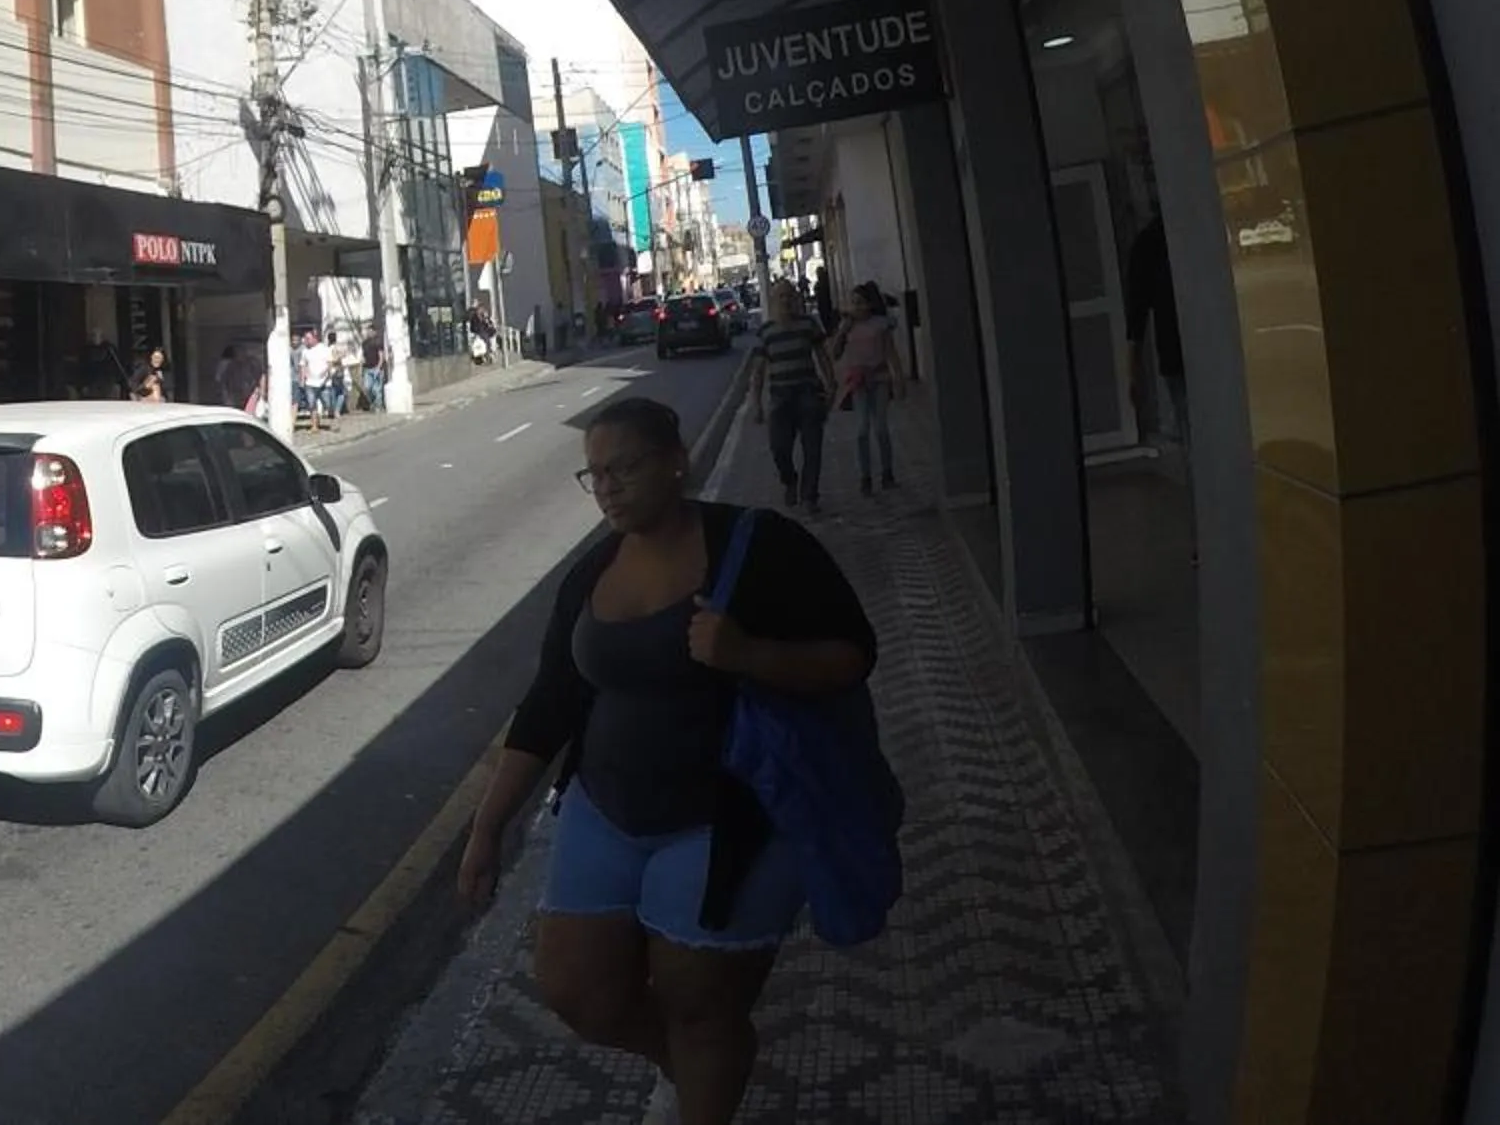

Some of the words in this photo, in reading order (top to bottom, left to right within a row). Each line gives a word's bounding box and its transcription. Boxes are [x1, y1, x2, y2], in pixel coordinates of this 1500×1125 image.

[718, 10, 931, 80] JUVENTUDE
[745, 64, 916, 113] CALÇADOS
[137, 234, 178, 262] POLO
[181, 241, 216, 265] NTPK
